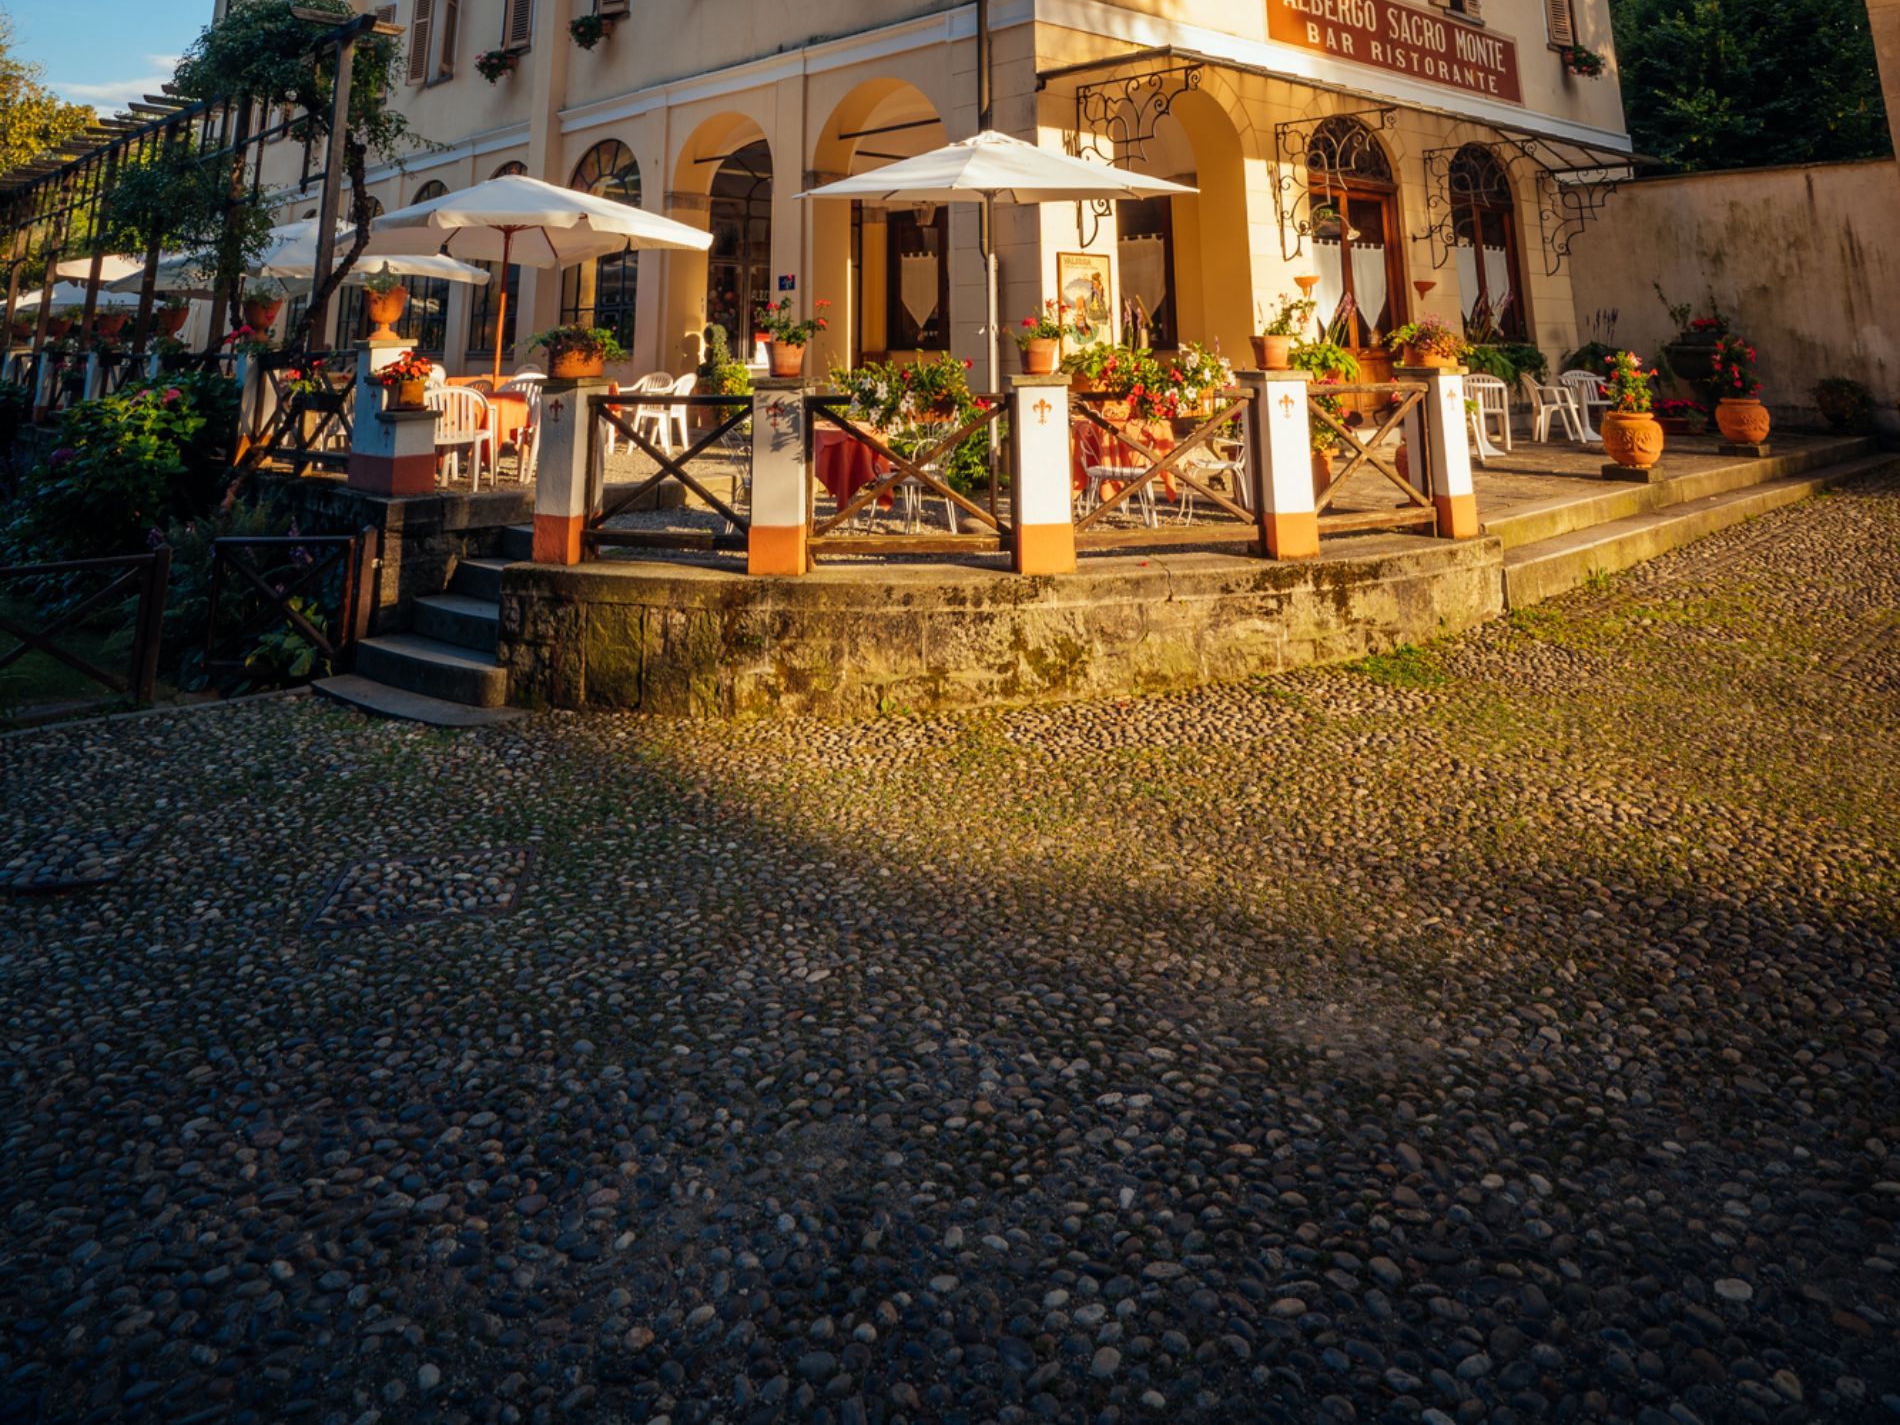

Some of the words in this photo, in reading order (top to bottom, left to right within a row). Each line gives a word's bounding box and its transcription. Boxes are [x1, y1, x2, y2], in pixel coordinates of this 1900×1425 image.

[1306, 21, 1354, 54] BAR
[1370, 40, 1498, 93] RISTORANTE
[1387, 7, 1446, 53] SACRO
[1455, 28, 1506, 73] MONTE
